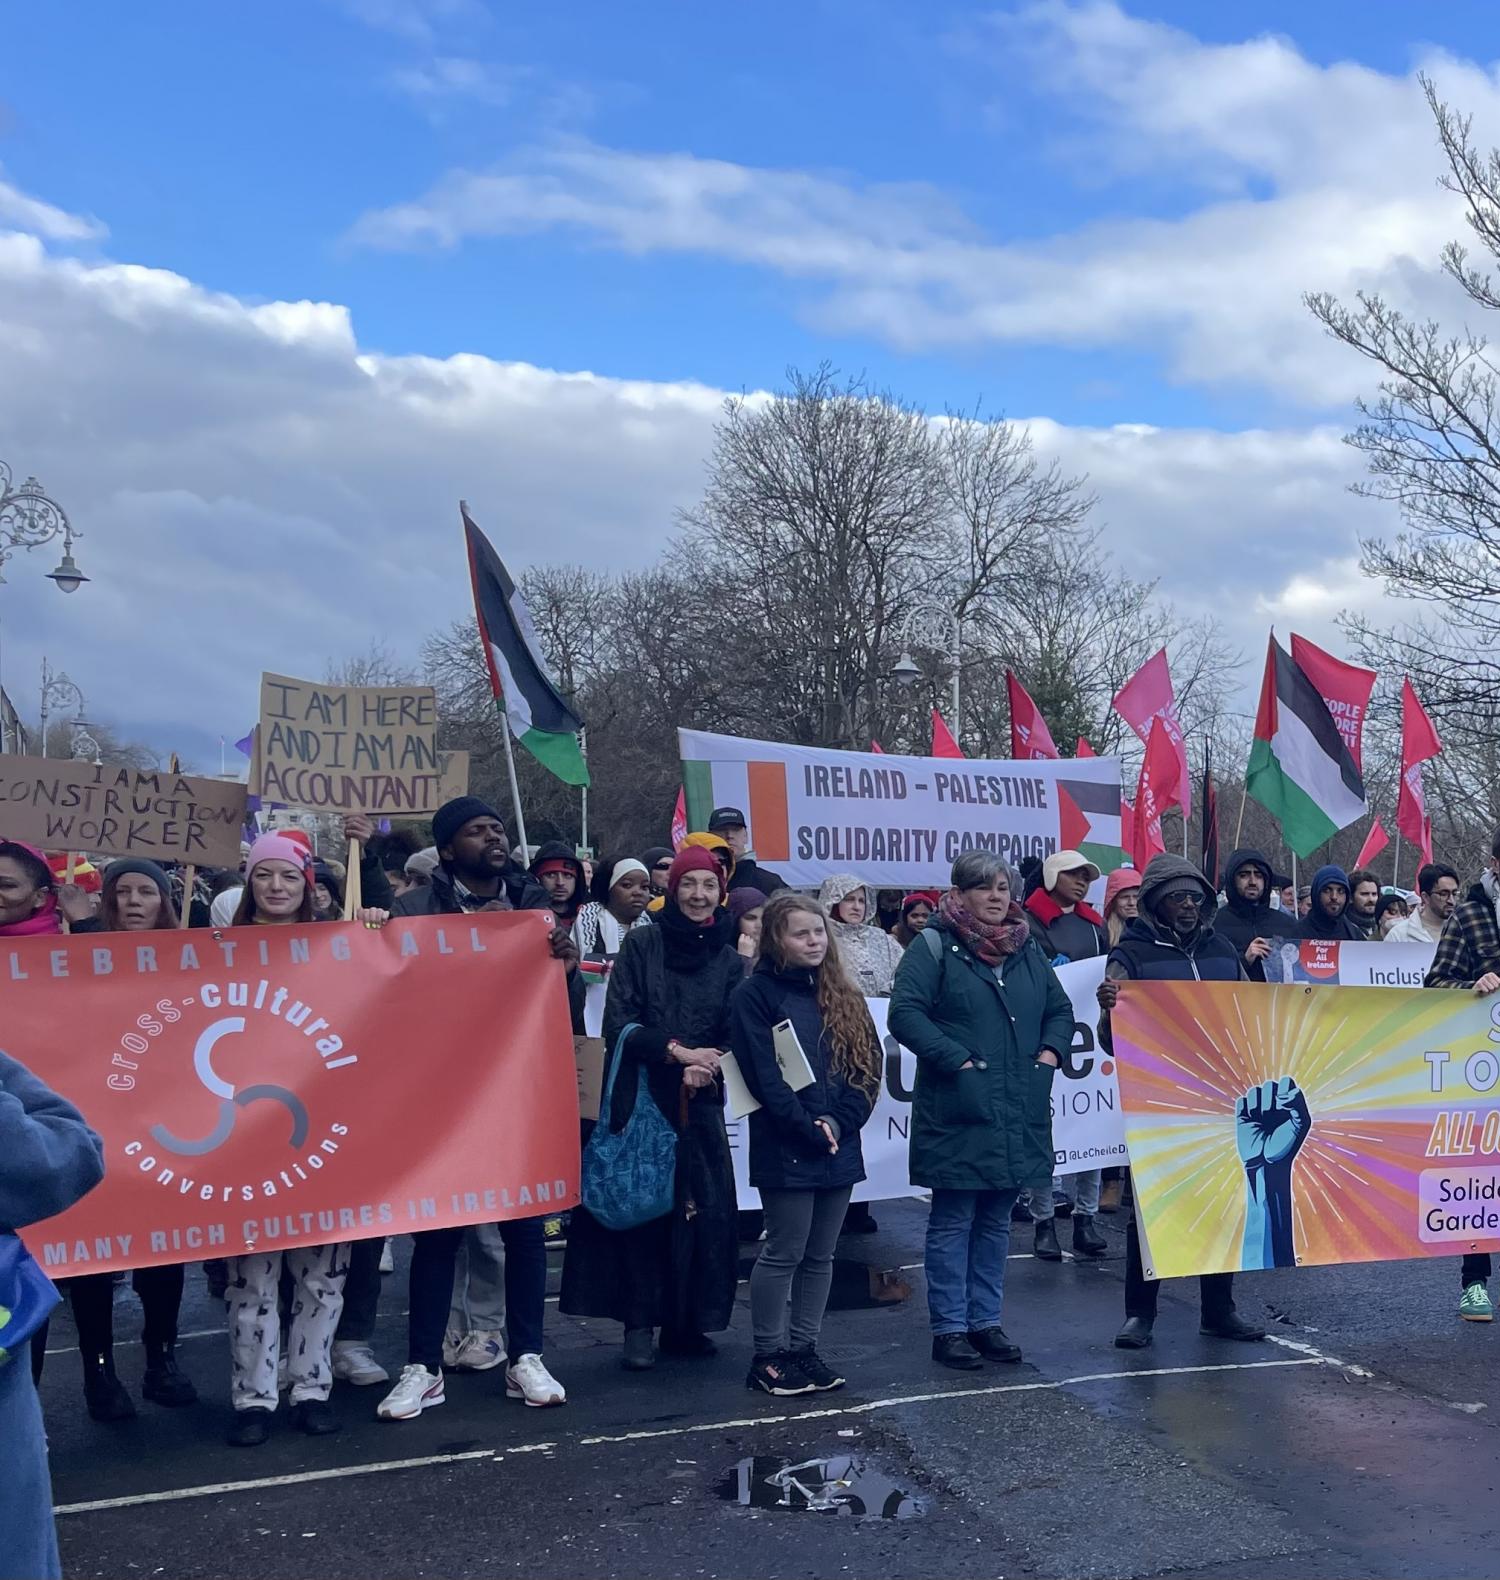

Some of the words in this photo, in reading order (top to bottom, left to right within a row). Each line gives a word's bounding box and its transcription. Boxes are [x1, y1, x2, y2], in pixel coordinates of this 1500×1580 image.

[267, 682, 300, 721] I
[304, 691, 348, 727] AM
[362, 695, 434, 727] HERE
[1323, 698, 1361, 719] OPLE
[267, 722, 321, 764] AND
[323, 732, 347, 768] I
[352, 732, 396, 771] AM
[400, 733, 436, 770] AN
[93, 765, 103, 783] I
[114, 768, 160, 793] AM
[173, 778, 195, 797] A
[263, 761, 441, 809] ACCOUNTANT
[804, 765, 907, 800] IRELAND
[935, 773, 1048, 809] PALESTINE
[46, 814, 207, 852] WORKER
[798, 826, 937, 863] SOLIDARITY
[9, 934, 353, 980] LEBRATING
[400, 927, 487, 957] ALL
[1370, 967, 1425, 985] Inclusi
[1069, 1144, 1128, 1160] @LeCheileD
[1425, 1111, 1479, 1156] ALL
[124, 1121, 349, 1202] conversations
[43, 1234, 134, 1266] MANY
[151, 1223, 226, 1252] RICH
[242, 1202, 393, 1241] CULTURES
[408, 1199, 437, 1219] IN
[452, 1179, 568, 1213] IRELAND
